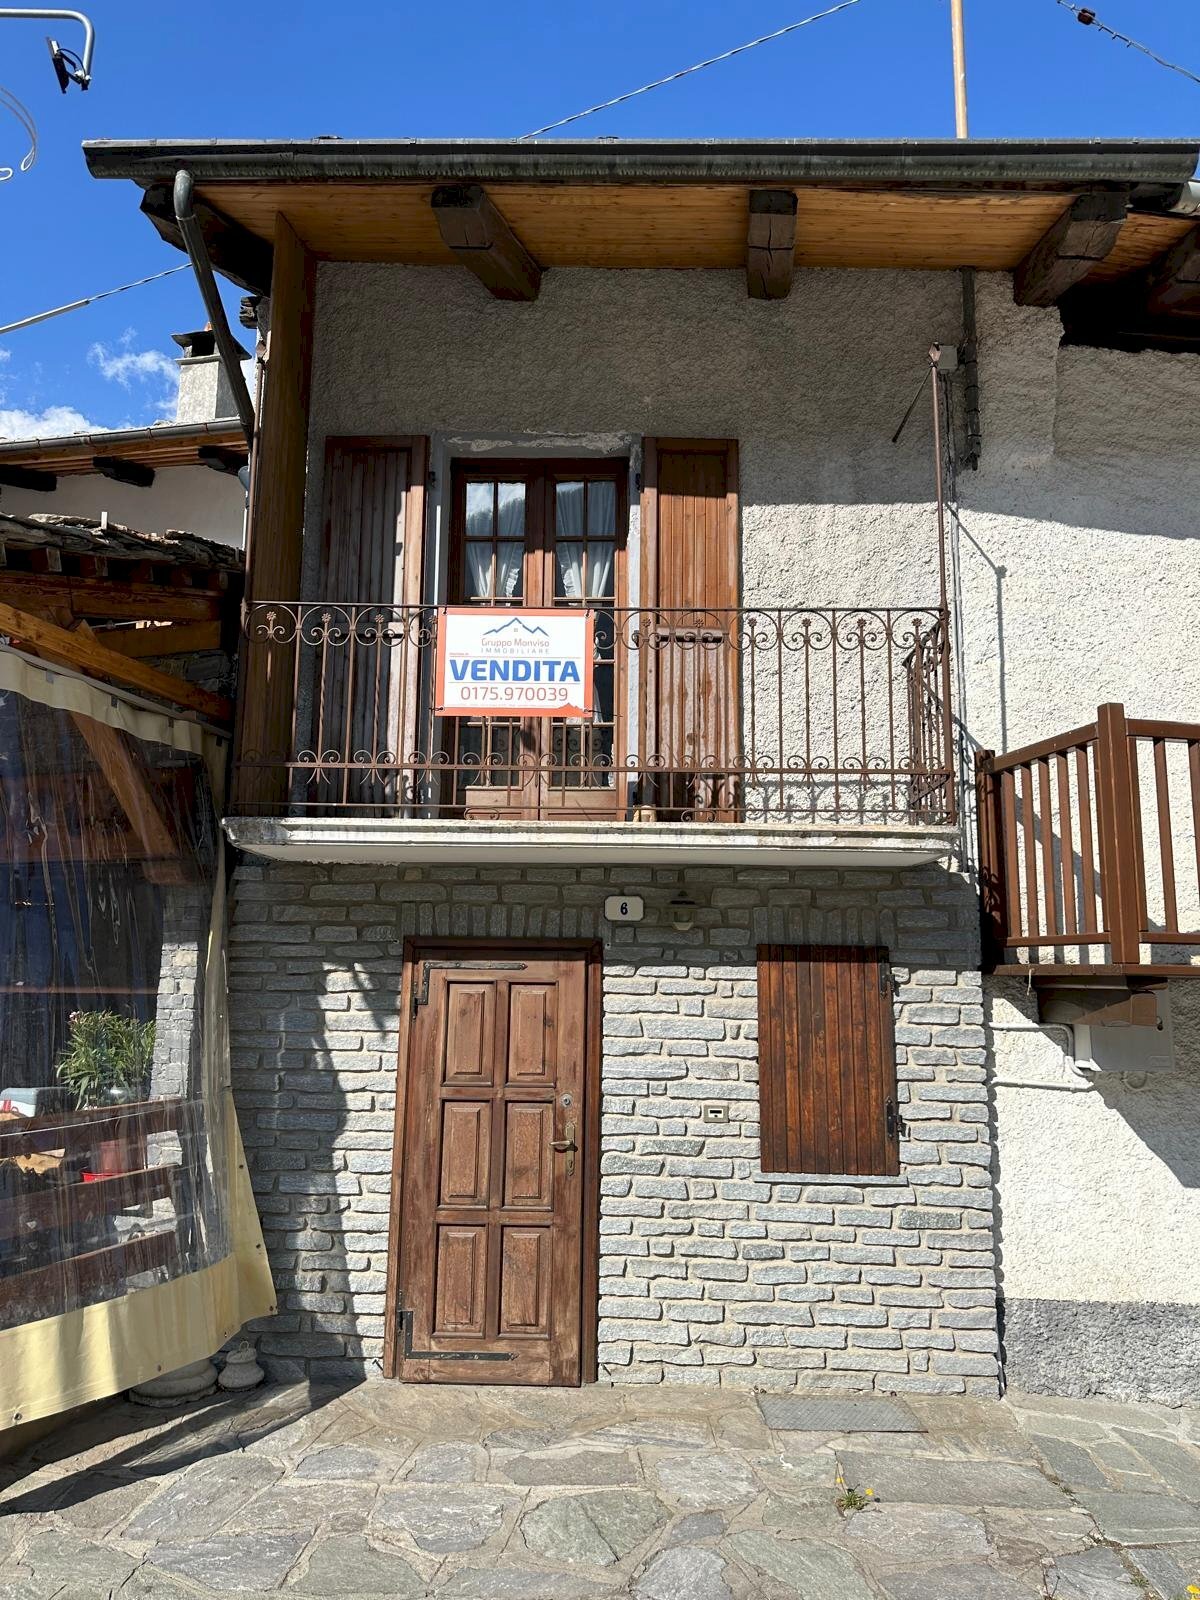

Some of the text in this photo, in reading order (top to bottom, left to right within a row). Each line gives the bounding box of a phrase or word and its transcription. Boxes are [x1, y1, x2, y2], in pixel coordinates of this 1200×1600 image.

[481, 637, 550, 648] Gruppo Monviso
[449, 659, 581, 682] VENDITA
[460, 686, 568, 701] 0175.970039
[620, 902, 628, 915] 6
